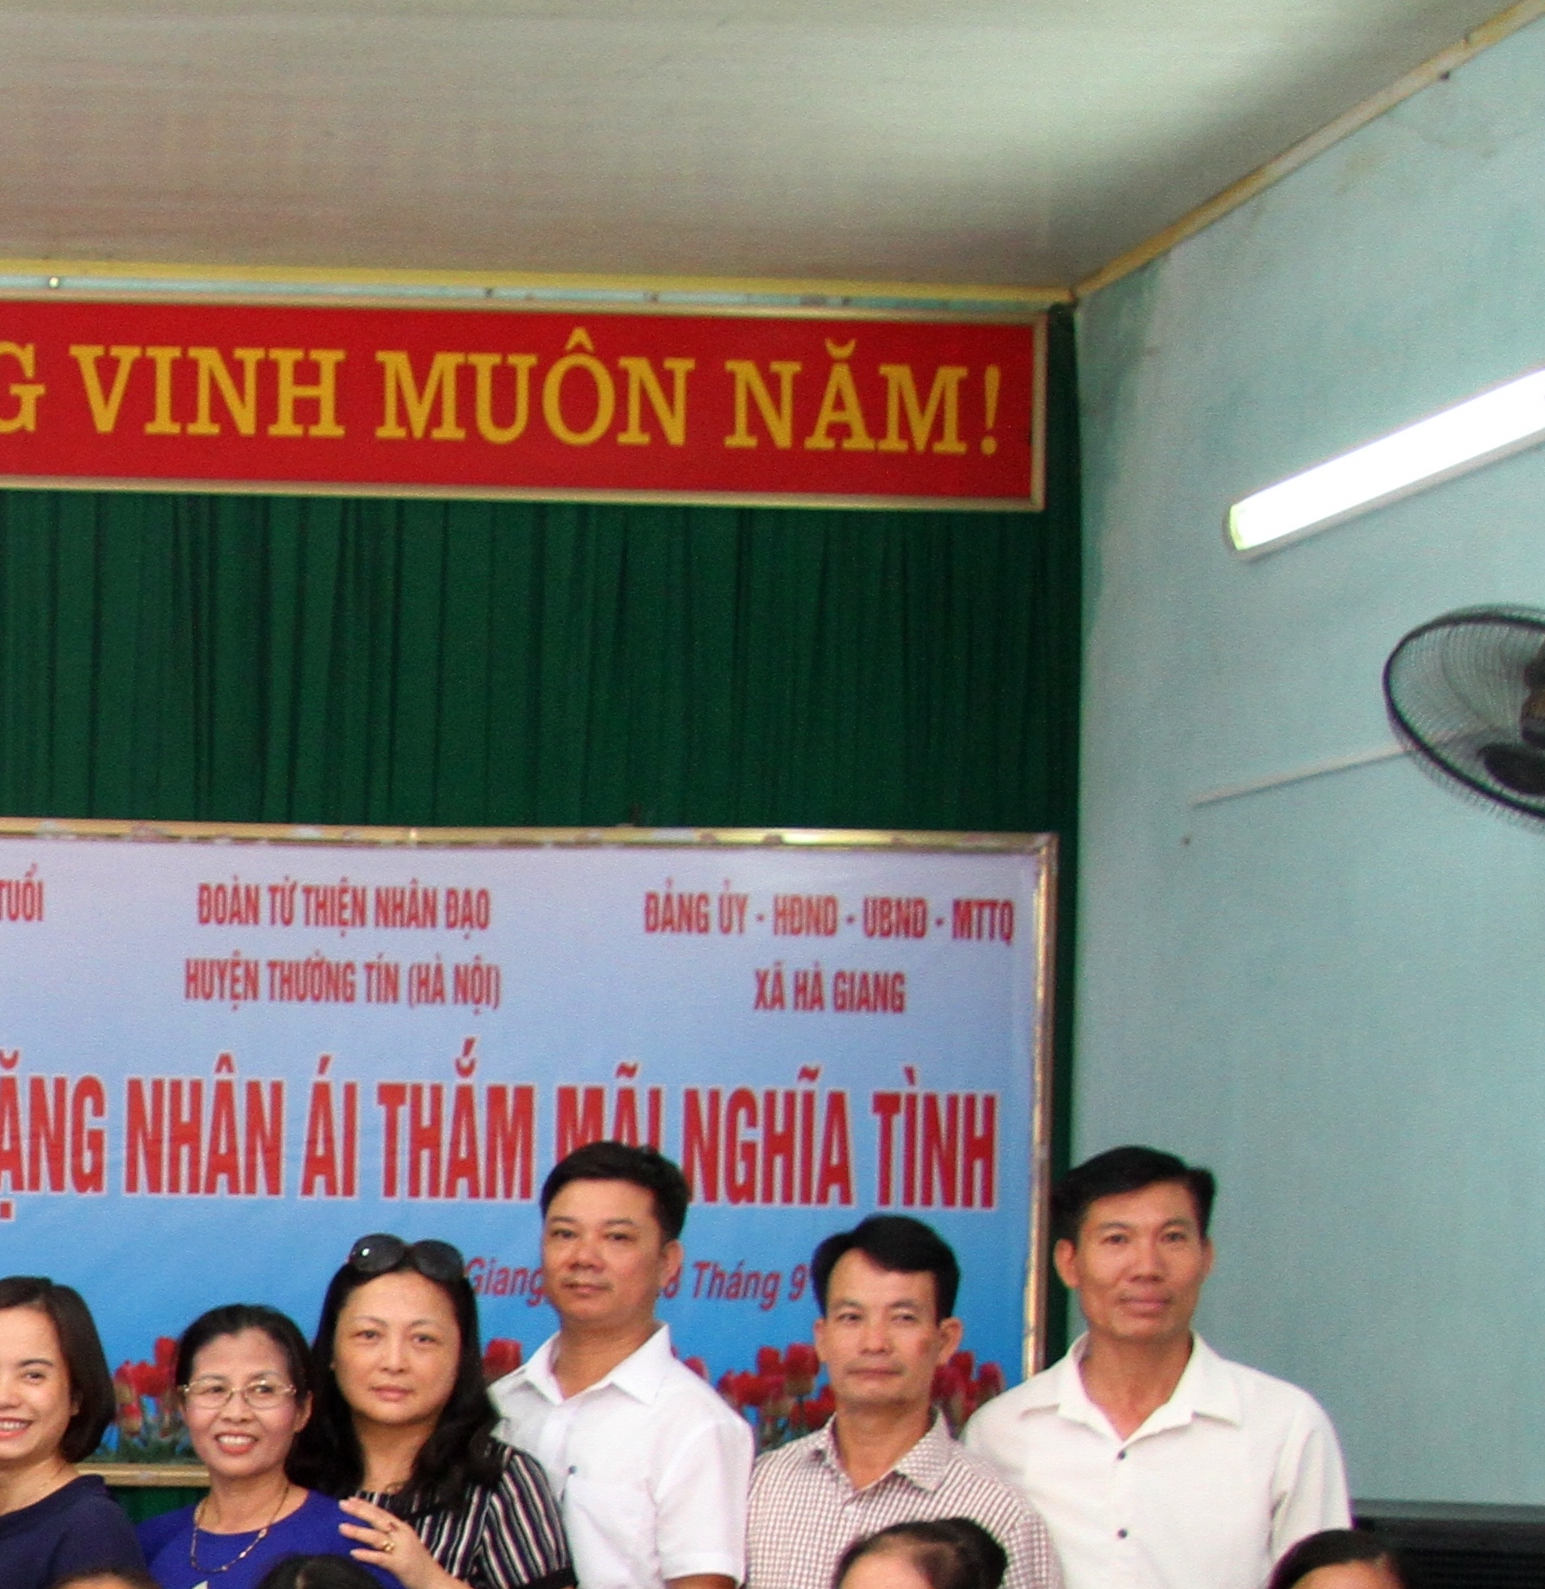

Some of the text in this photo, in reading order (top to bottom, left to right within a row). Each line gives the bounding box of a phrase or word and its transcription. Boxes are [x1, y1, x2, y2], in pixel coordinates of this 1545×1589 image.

[70, 346, 344, 436] VINH
[376, 329, 694, 444] MUÔN
[726, 344, 1001, 456] NĂM!
[197, 876, 491, 938] ĐOÀN TỪ THIỆN NHÂN ĐẠO
[644, 877, 710, 934] ĐẢNG
[863, 897, 928, 938] UBND
[952, 899, 1015, 943] MTTQ
[185, 950, 500, 1014] HUYỆN THƯỜNG TÍN (HÀ NỘI)
[754, 962, 905, 1013] XÃ HÀ GIANG
[126, 1055, 283, 1195] NHÂN
[302, 1057, 357, 1196] ÁI
[378, 1036, 534, 1199] THẮM
[681, 1068, 852, 1204] NGHĨA
[874, 1069, 995, 1207] TÌNH
[692, 1262, 780, 1309] Tháng
